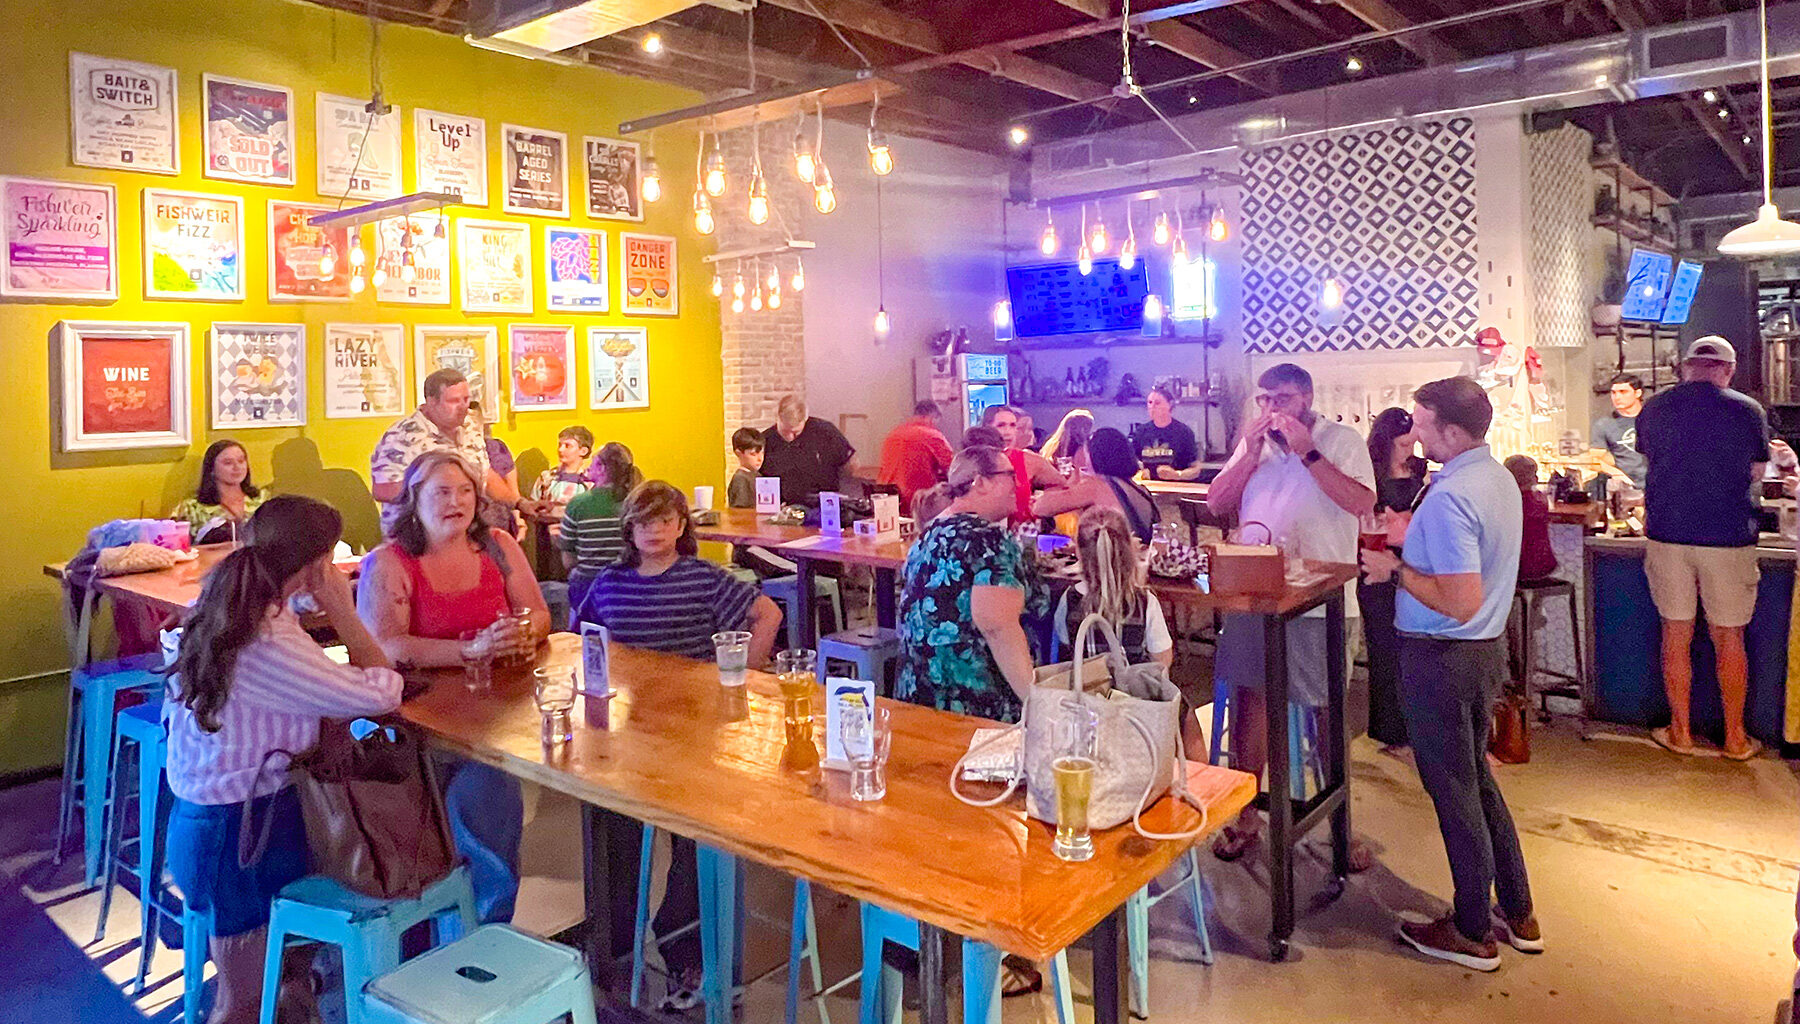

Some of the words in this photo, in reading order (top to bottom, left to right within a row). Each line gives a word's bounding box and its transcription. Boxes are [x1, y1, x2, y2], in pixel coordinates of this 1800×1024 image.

[104, 73, 150, 91] BAIT&
[96, 87, 153, 106] SWITCH
[429, 118, 471, 137] Level
[229, 135, 270, 156] SOLD
[442, 131, 460, 152] Up
[515, 141, 552, 157] BARREL
[235, 157, 269, 174] OUT
[522, 155, 548, 169] AGED
[518, 168, 552, 183] SERIES
[630, 241, 666, 254] DANGER
[630, 253, 666, 270] ZONE
[335, 337, 377, 353] LAZY
[103, 367, 150, 382] WINE
